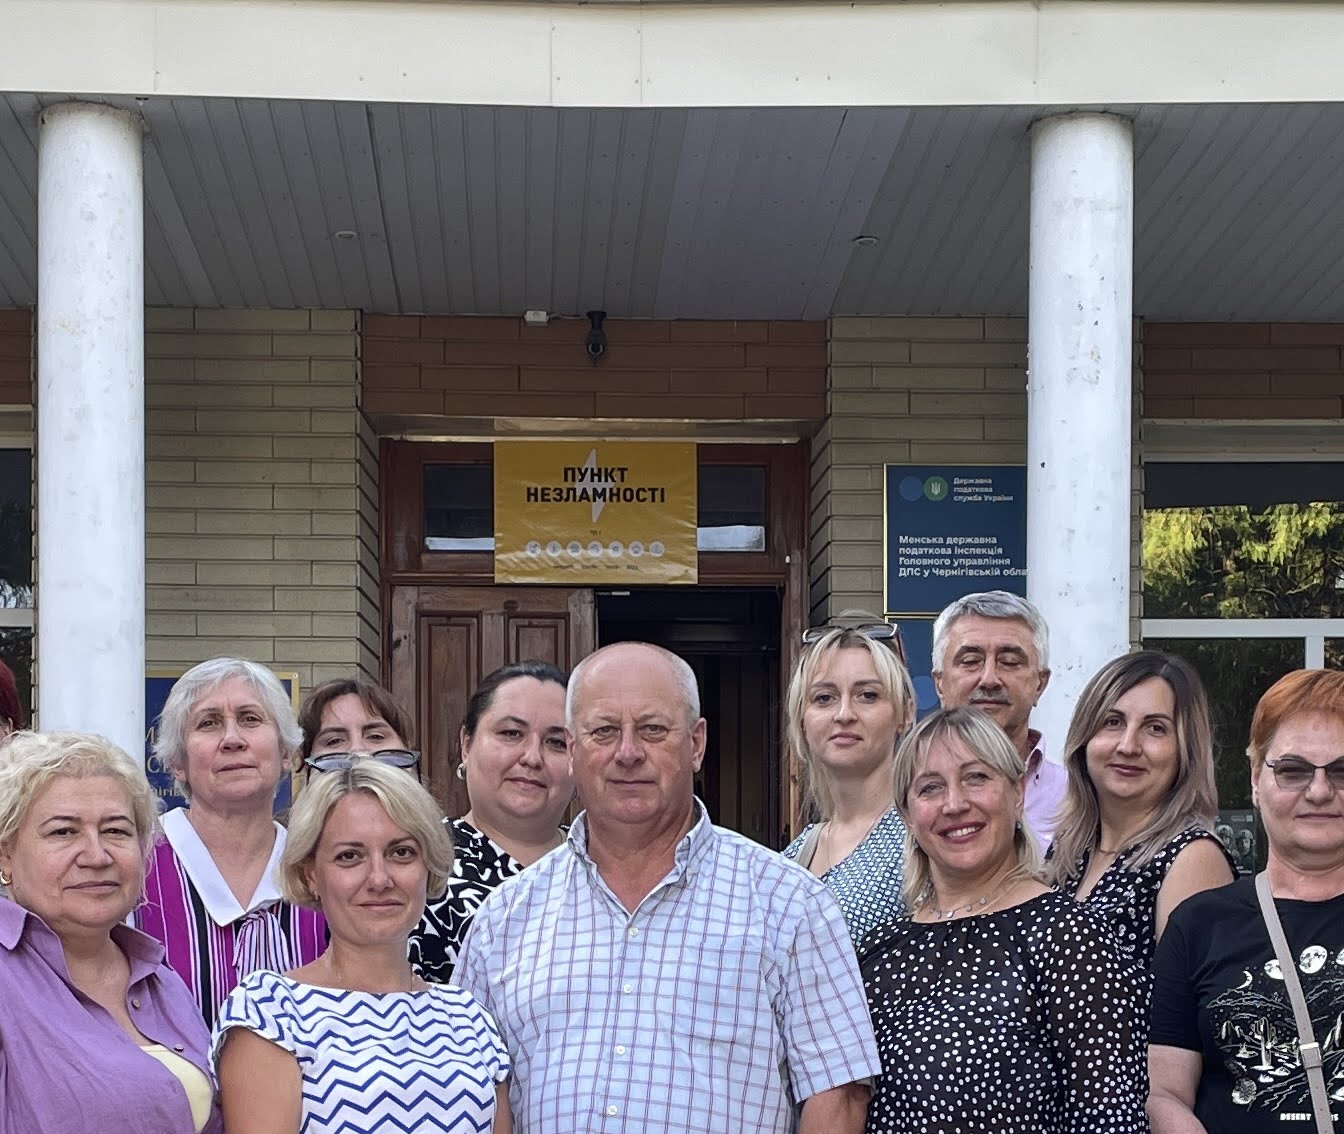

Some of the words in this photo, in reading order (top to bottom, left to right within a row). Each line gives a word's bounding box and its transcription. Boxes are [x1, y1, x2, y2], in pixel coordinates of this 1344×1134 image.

[563, 467, 629, 483] ПУНКТ
[953, 477, 992, 485] Державна
[526, 487, 666, 503] НЕЗЛАМНОСТІ
[898, 535, 944, 544] Менська
[946, 536, 998, 545] державна
[898, 548, 952, 556] податкова
[954, 546, 1003, 555] інспекція
[898, 557, 950, 565] Головного
[953, 557, 1011, 566] управління
[898, 568, 921, 577] ДПС
[923, 569, 930, 578] у
[931, 567, 1001, 577] Чернігівській
[1279, 1112, 1312, 1121] DESERT
